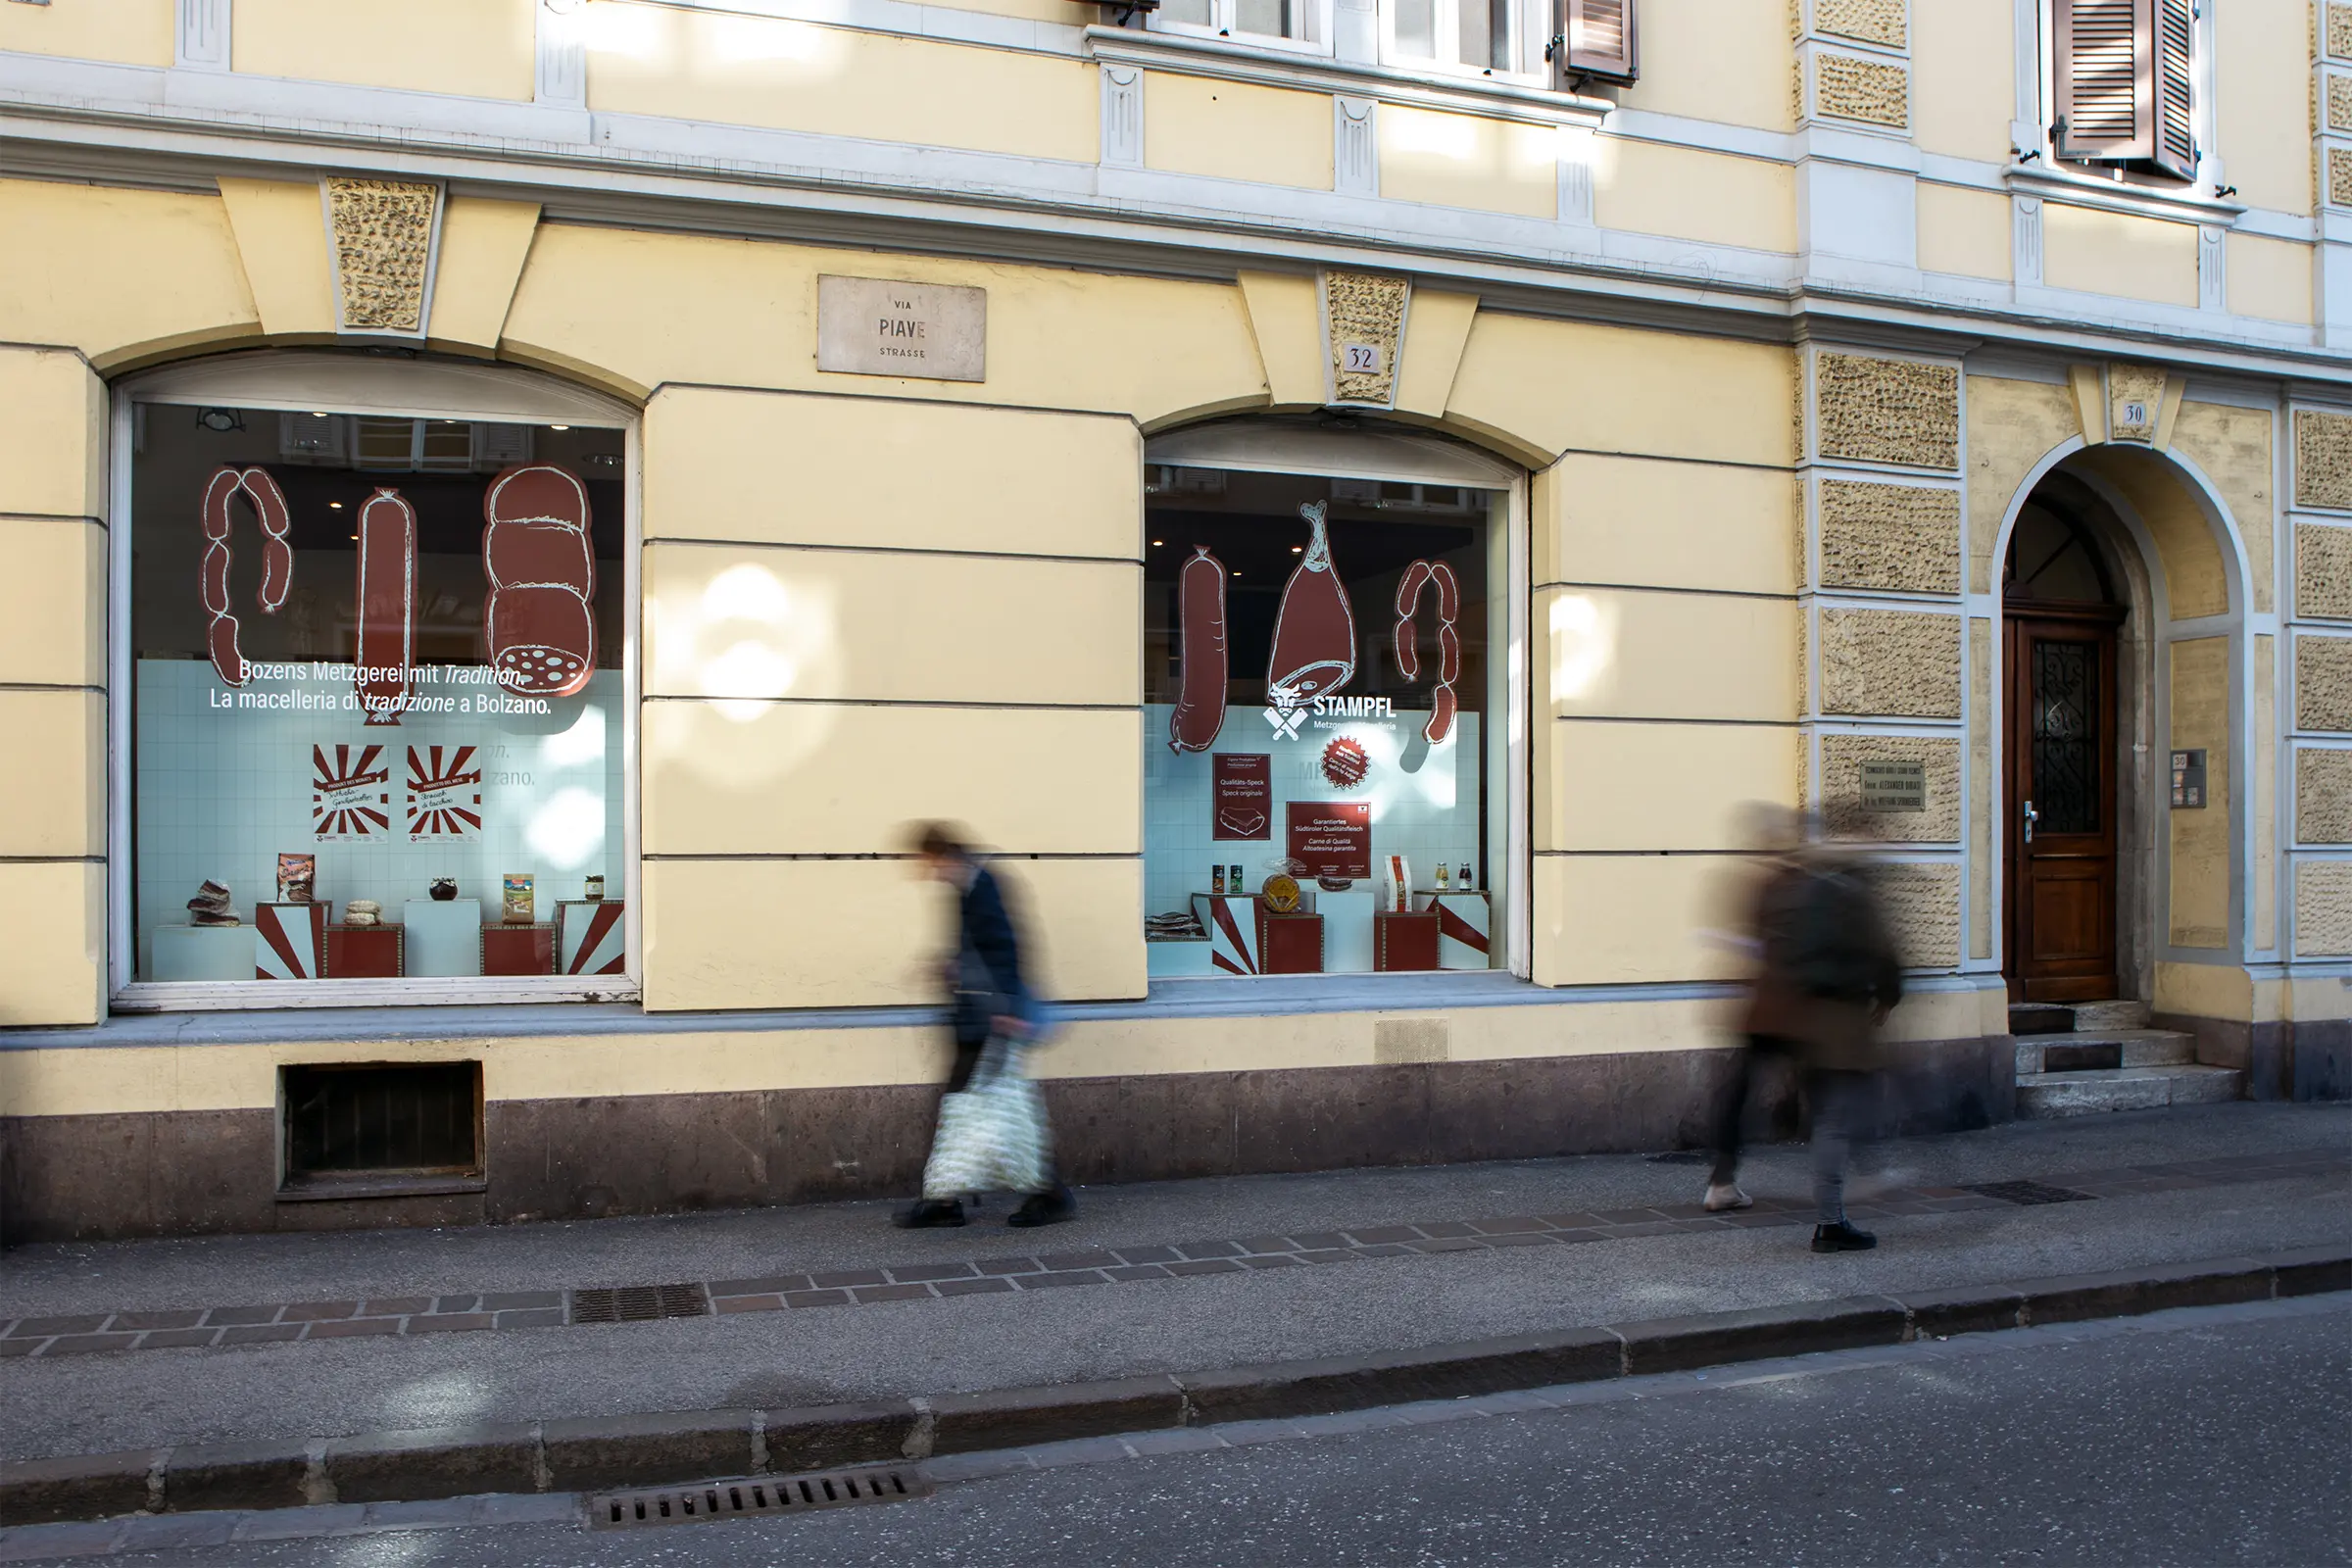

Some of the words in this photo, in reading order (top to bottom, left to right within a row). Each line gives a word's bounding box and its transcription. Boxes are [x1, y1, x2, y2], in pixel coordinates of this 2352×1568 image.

[894, 300, 911, 310] VIA
[879, 318, 926, 339] PIAVE
[880, 347, 925, 358] STRASSE
[1349, 348, 1371, 368] 32
[2127, 405, 2142, 422] 30
[239, 660, 307, 680] Bozens
[313, 661, 404, 686] Metzgerei
[410, 663, 439, 684] mit
[445, 664, 525, 686] Tradition.
[210, 688, 232, 709] La
[239, 689, 336, 710] macelleria
[343, 690, 359, 710] di
[366, 691, 455, 713] tradizione
[460, 698, 470, 712] a
[476, 693, 552, 714] Bolzano.
[1313, 695, 1396, 717] STAMPFL
[1313, 720, 1351, 731] Metzge
[2175, 757, 2185, 765] 30
